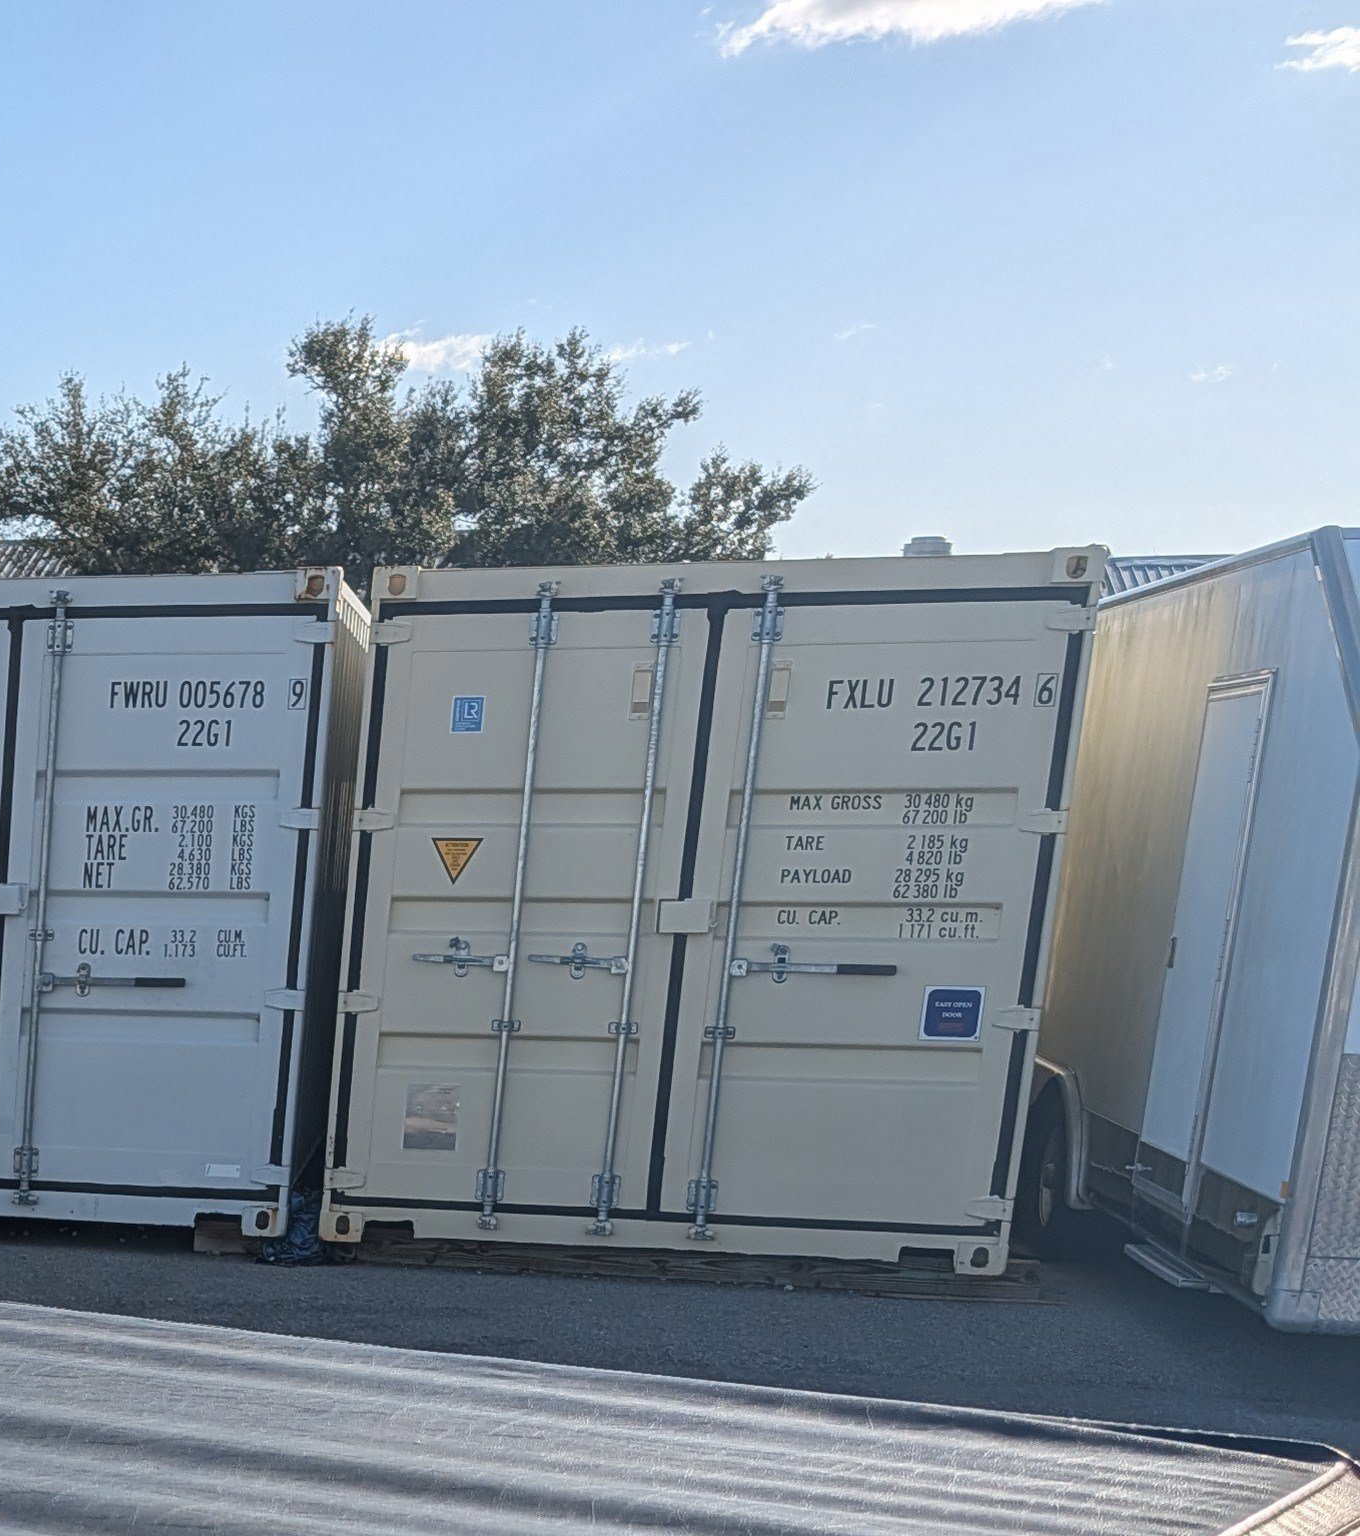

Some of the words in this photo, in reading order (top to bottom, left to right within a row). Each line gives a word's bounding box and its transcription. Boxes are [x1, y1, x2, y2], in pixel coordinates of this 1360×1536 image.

[109, 680, 168, 709] FWRU
[179, 680, 266, 709] 005678
[290, 679, 306, 709] 9
[825, 678, 895, 709] FXLU
[916, 675, 1022, 707] 212734
[1036, 674, 1057, 706] 6
[176, 719, 232, 747] 22G1
[910, 721, 977, 752] 22G1
[789, 795, 823, 811] MAX
[830, 795, 882, 811] GROSS
[955, 793, 974, 812] kg
[86, 805, 159, 833] MAX.GR.
[172, 804, 214, 820] 30.480
[233, 804, 256, 819] KGS
[171, 819, 213, 834] 67.200
[232, 819, 255, 834] LBS
[953, 809, 968, 825] lb
[85, 834, 128, 861] TARE
[178, 834, 212, 848] 2.100
[232, 833, 254, 848] KGS
[786, 835, 825, 851] TARE
[949, 834, 969, 854] kg
[177, 847, 212, 862] 4.630
[231, 847, 253, 862] LBS
[948, 850, 963, 866] lb
[83, 861, 115, 889] NET
[169, 862, 211, 876] 28.380
[230, 862, 252, 876] KGS
[168, 876, 210, 890] 62.570
[229, 876, 251, 890] LBS
[780, 868, 852, 884] PAYLOAD
[945, 868, 965, 887] kg
[943, 884, 958, 899] lb
[777, 909, 800, 925] CU.
[808, 910, 841, 926] CAP.
[905, 908, 935, 923] 33.2
[940, 911, 984, 923] cu.m.
[938, 924, 979, 939] cu.ft.
[78, 929, 105, 955] CU.
[115, 929, 151, 956] CAP.
[170, 929, 197, 944] 33.2
[163, 943, 196, 958] 1.173
